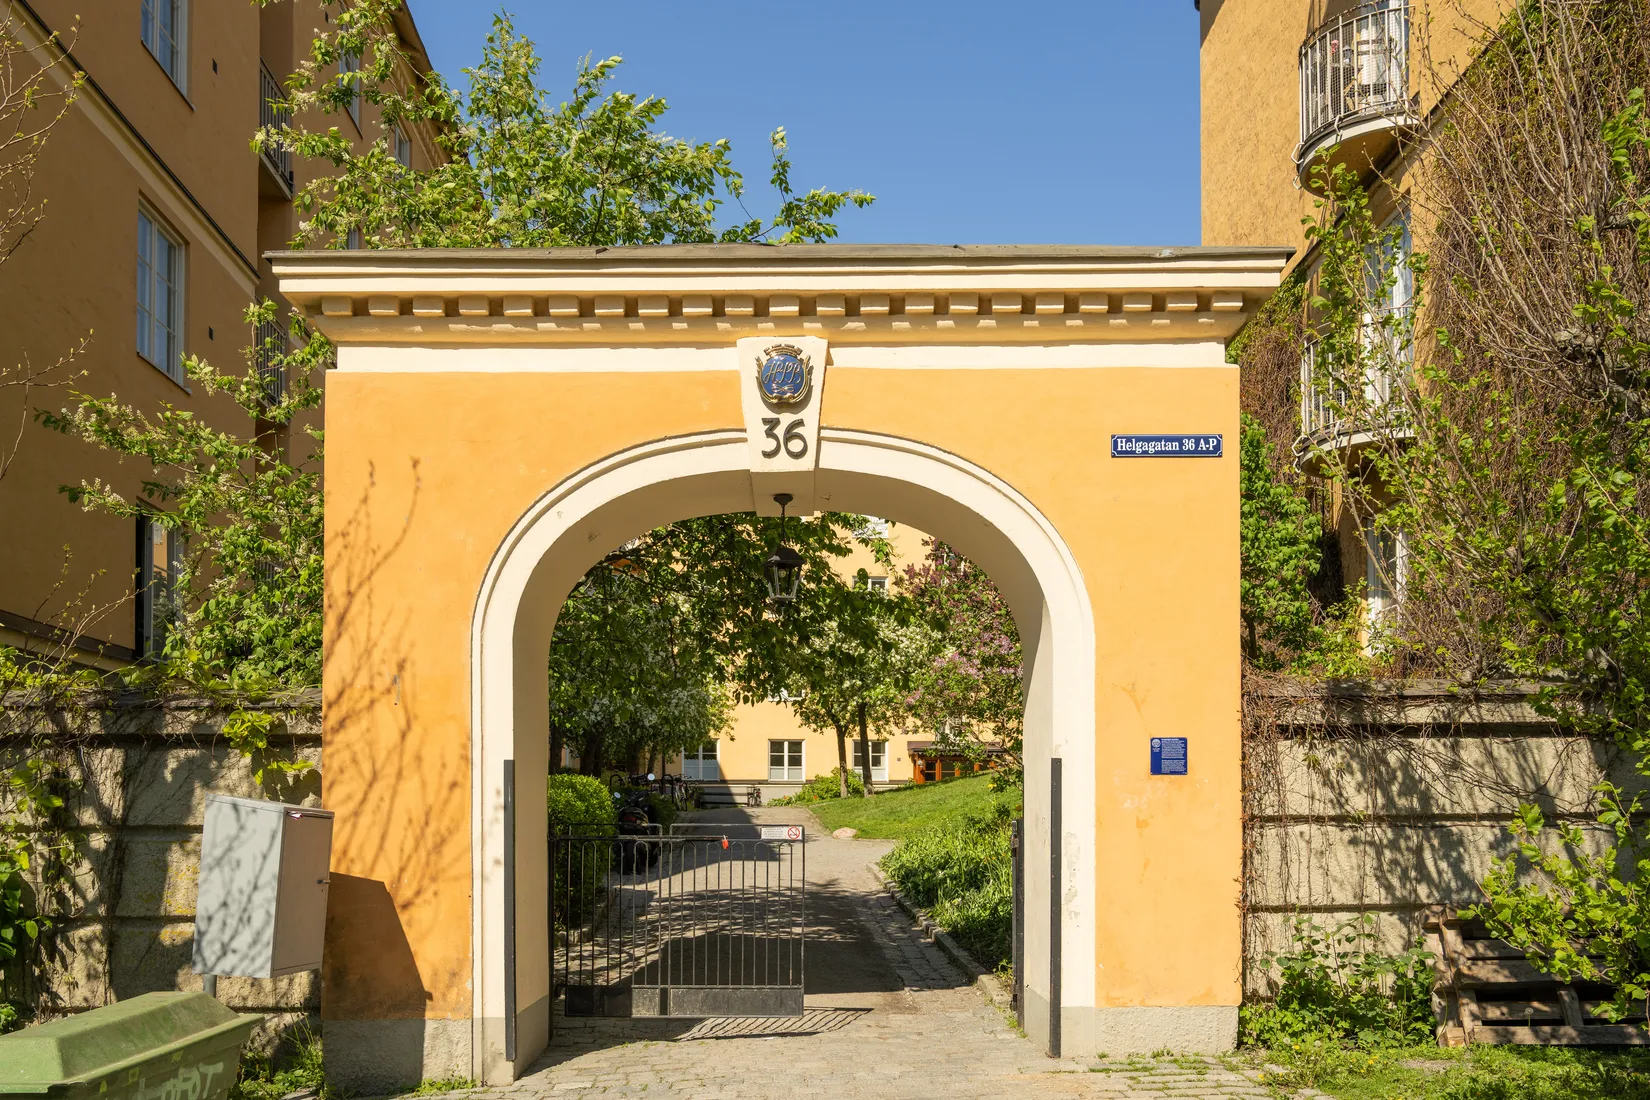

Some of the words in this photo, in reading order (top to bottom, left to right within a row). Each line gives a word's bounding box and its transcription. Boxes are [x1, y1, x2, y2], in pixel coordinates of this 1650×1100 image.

[761, 417, 808, 459] 36
[1117, 438, 1180, 454] Helgagatan
[1182, 438, 1196, 451] 36
[1198, 438, 1217, 451] A-P
